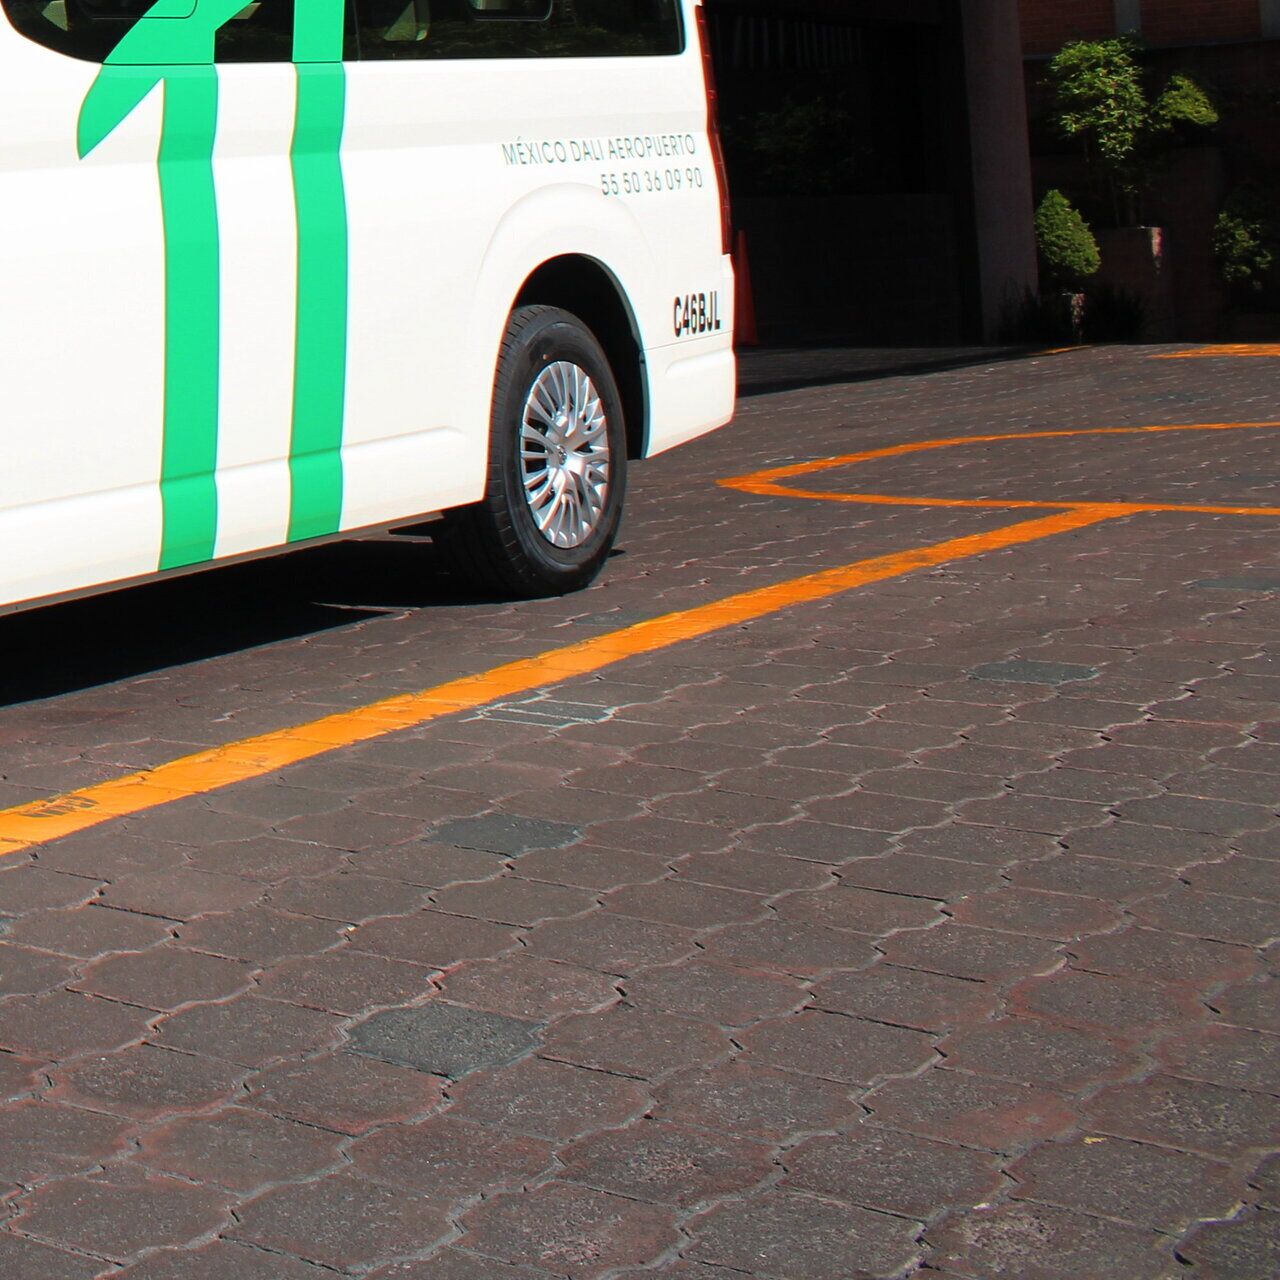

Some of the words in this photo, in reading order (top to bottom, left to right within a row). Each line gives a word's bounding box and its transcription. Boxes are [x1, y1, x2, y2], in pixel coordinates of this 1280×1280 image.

[502, 135, 567, 166] MÉXICO
[569, 139, 605, 163] DALI
[608, 133, 697, 160] AEROPUERTO
[600, 173, 620, 196] 55
[622, 171, 641, 195] 50
[644, 170, 663, 193] 36
[664, 168, 682, 191] 09
[685, 166, 704, 189] 90
[674, 290, 721, 338] C46BJL
